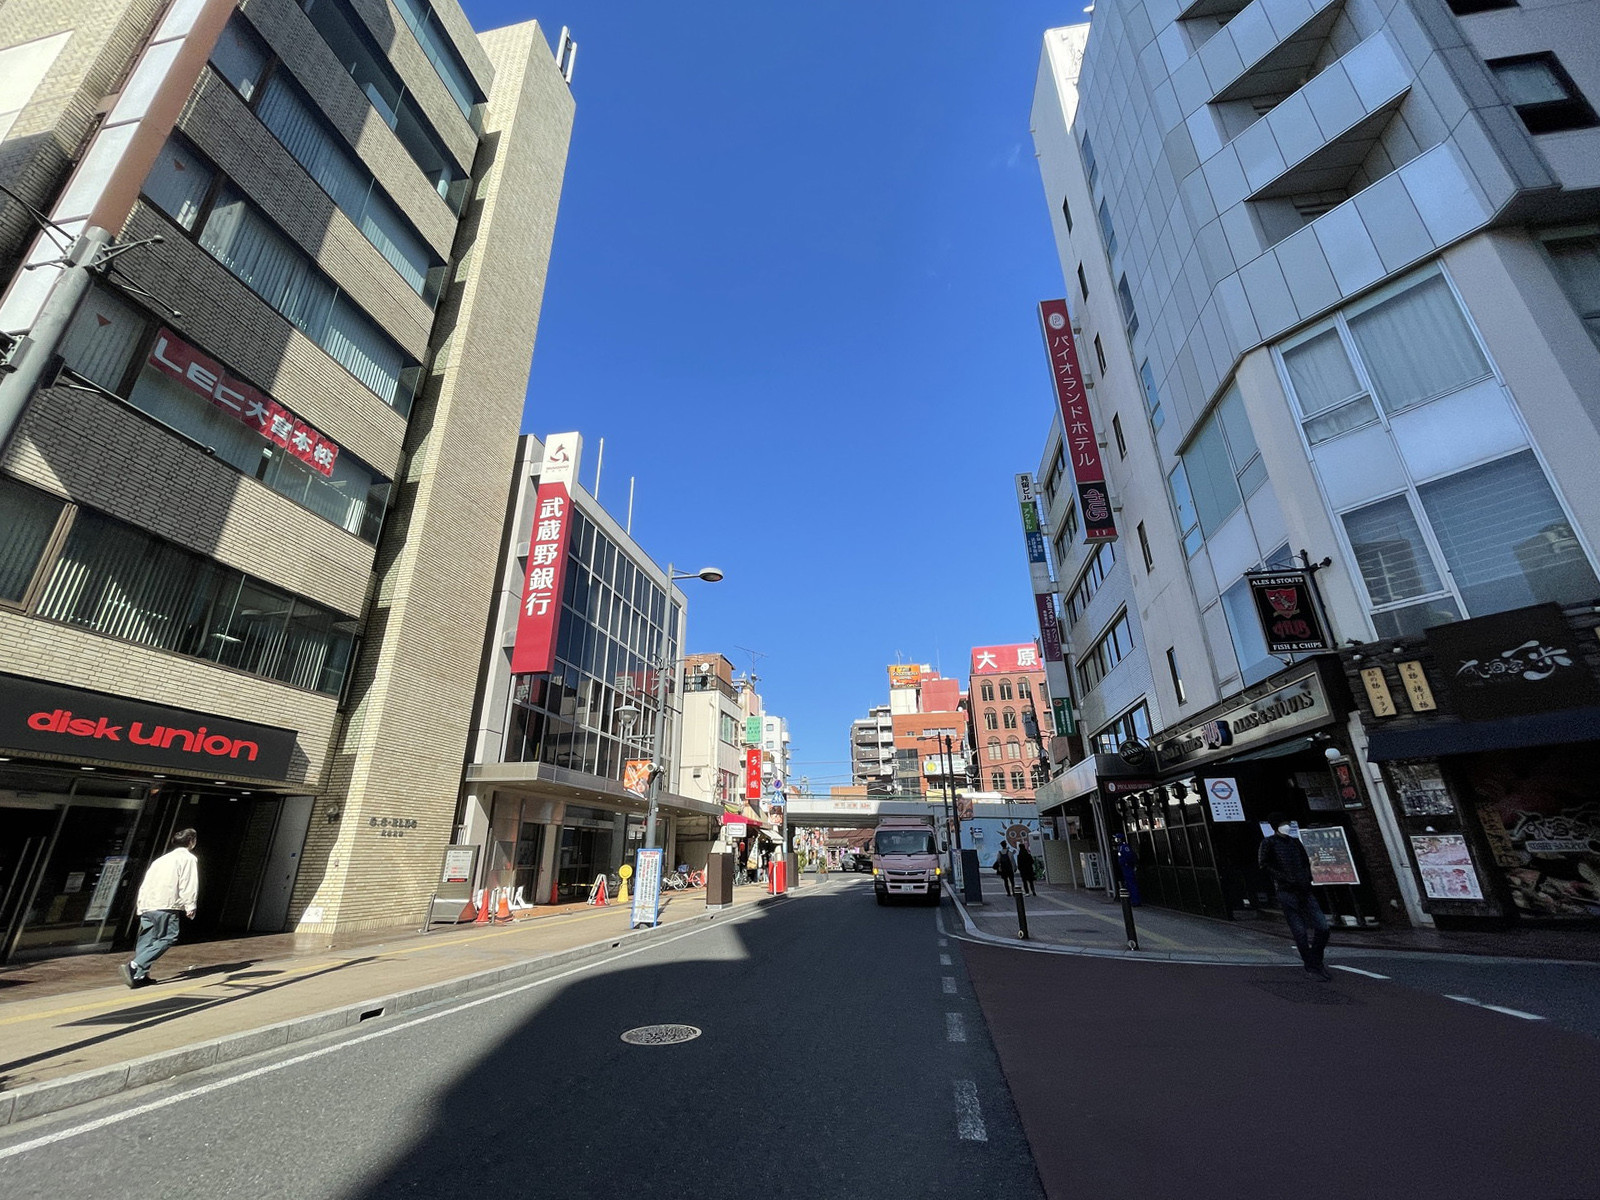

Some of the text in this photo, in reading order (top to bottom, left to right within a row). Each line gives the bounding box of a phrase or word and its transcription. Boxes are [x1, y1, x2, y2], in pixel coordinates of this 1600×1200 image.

[154, 336, 334, 469] LEC大宮本校
[1053, 335, 1095, 467] パイオランドホテル
[525, 496, 564, 617] 武蔵野銀行
[976, 647, 1038, 670] 大原
[1273, 643, 1291, 651] FISH
[1298, 641, 1323, 649] CHIPS
[27, 708, 259, 761] disk union
